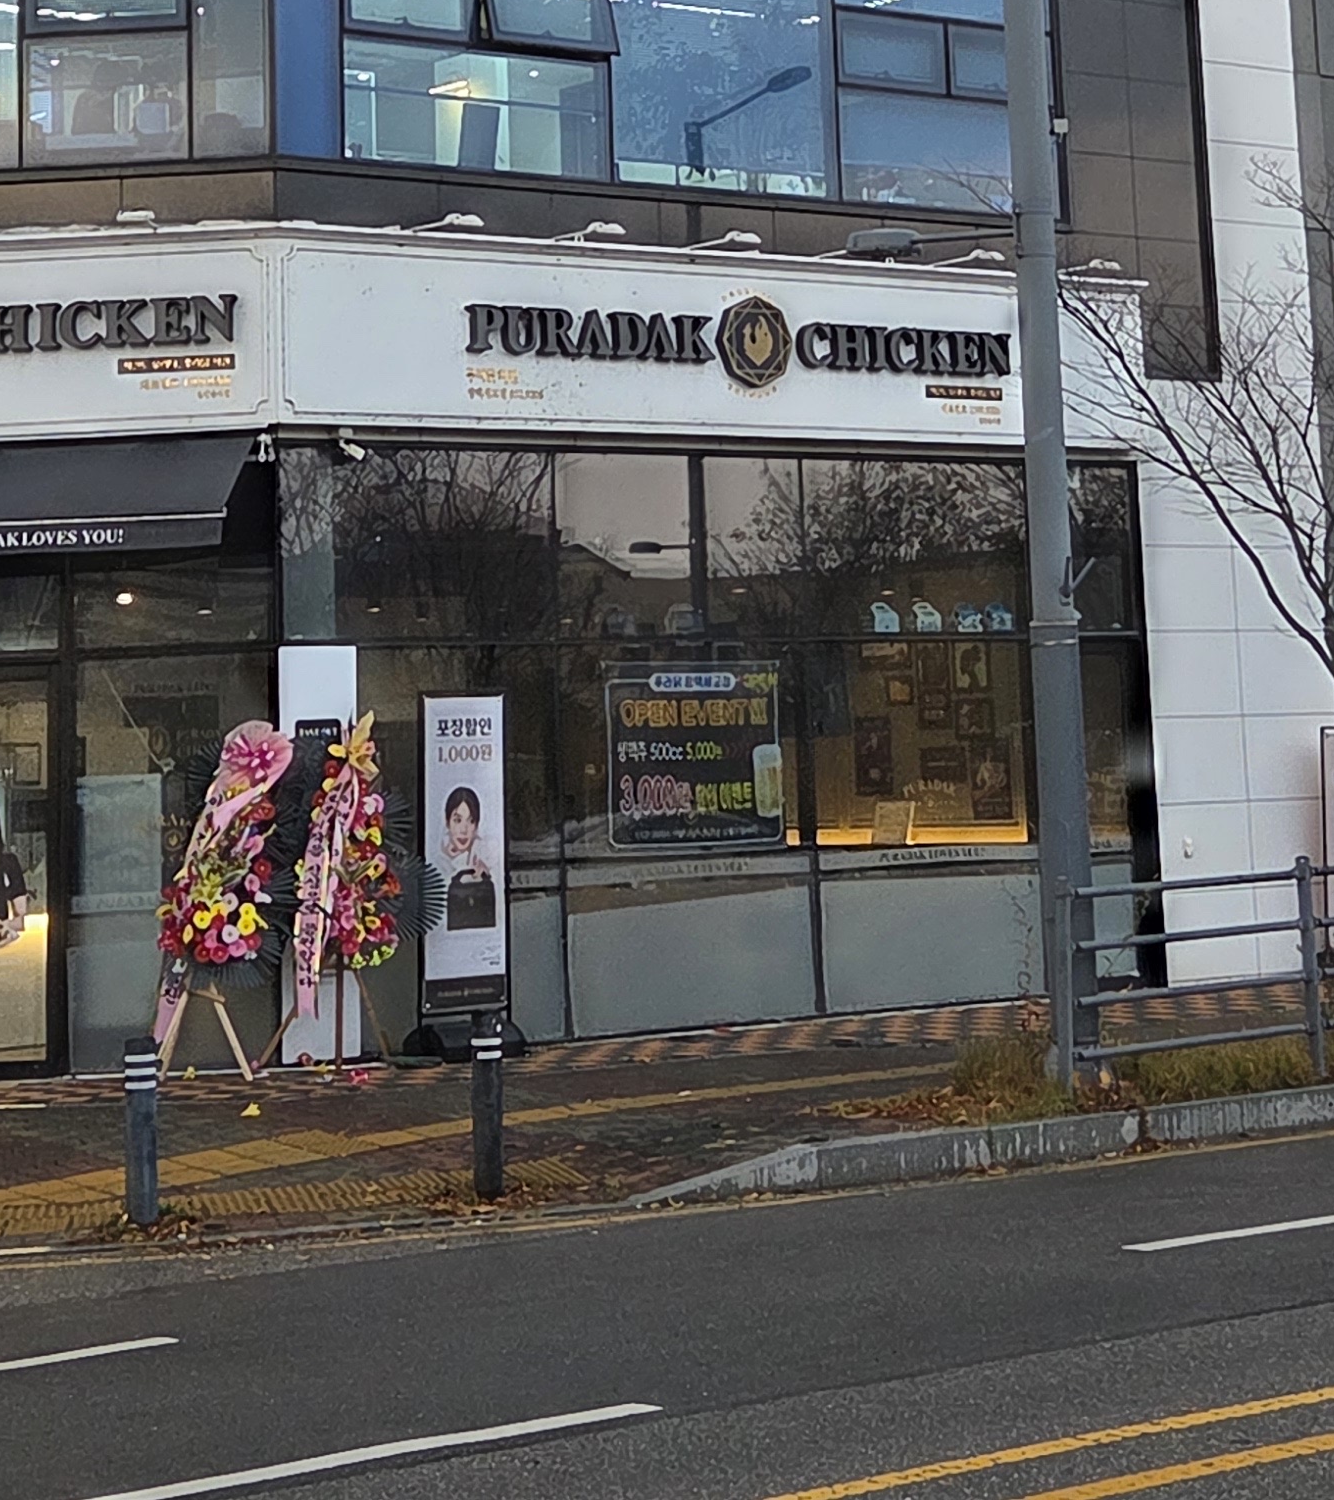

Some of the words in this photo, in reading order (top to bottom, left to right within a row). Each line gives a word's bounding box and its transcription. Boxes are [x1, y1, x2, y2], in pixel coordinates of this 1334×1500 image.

[464, 303, 716, 365] PURADAK
[796, 321, 1013, 378] CHICKEN
[22, 529, 78, 546] LOVES
[82, 528, 125, 545] YOU!
[620, 699, 678, 728] OPEN
[680, 698, 749, 727] EVENT
[435, 717, 492, 737] 포장할인
[438, 744, 493, 764] 1,000원
